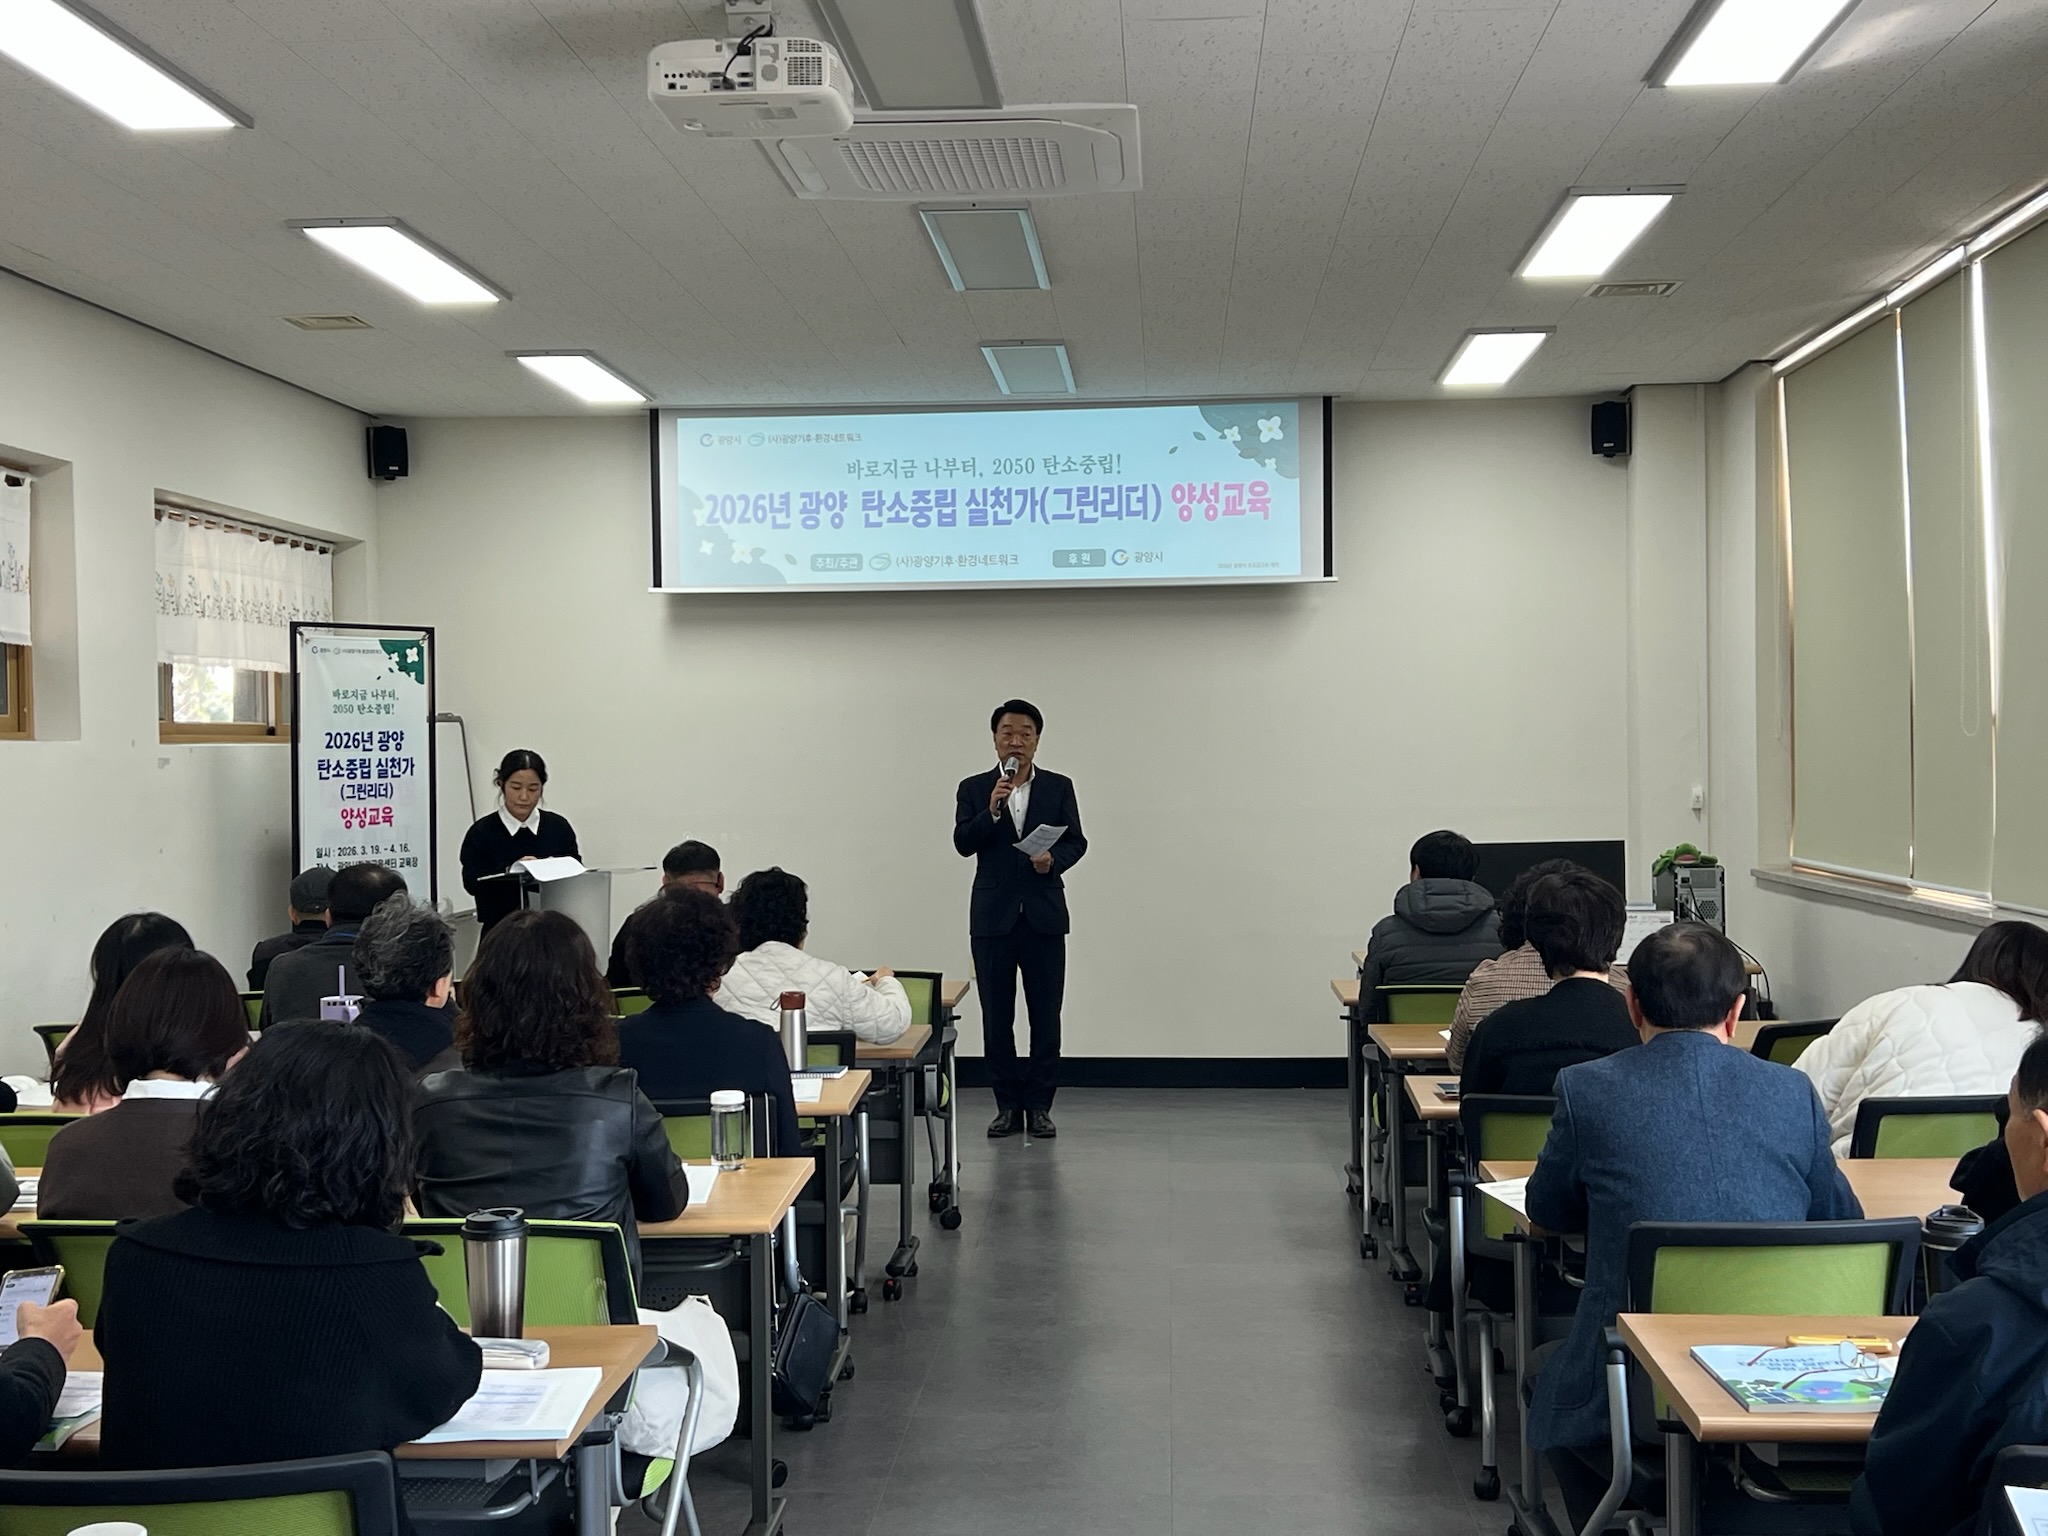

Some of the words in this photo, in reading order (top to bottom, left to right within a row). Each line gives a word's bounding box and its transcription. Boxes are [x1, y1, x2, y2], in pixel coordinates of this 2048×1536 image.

[846, 458, 918, 480] 바로지금
[924, 456, 985, 479] 나부터,
[992, 457, 1035, 476] 2050
[1042, 453, 1122, 476] 탄소중립!
[704, 490, 792, 531] 2026년
[799, 489, 848, 531] 광양
[861, 487, 958, 529] 탄소중립
[965, 482, 1162, 528] 실천가(그린리더)
[1170, 479, 1272, 523] 양성교육
[1134, 551, 1164, 564] 광양시
[332, 688, 368, 701] 바로지금
[332, 703, 354, 715] 2050
[357, 703, 396, 716] 탄소중립!
[324, 730, 374, 752] 2026년
[377, 729, 405, 752] 광양
[317, 757, 372, 781] 탄소중립
[375, 756, 416, 780] 실천가
[340, 782, 394, 801] (그린리더)
[340, 805, 395, 830] 양성교육
[315, 847, 331, 859] 일시
